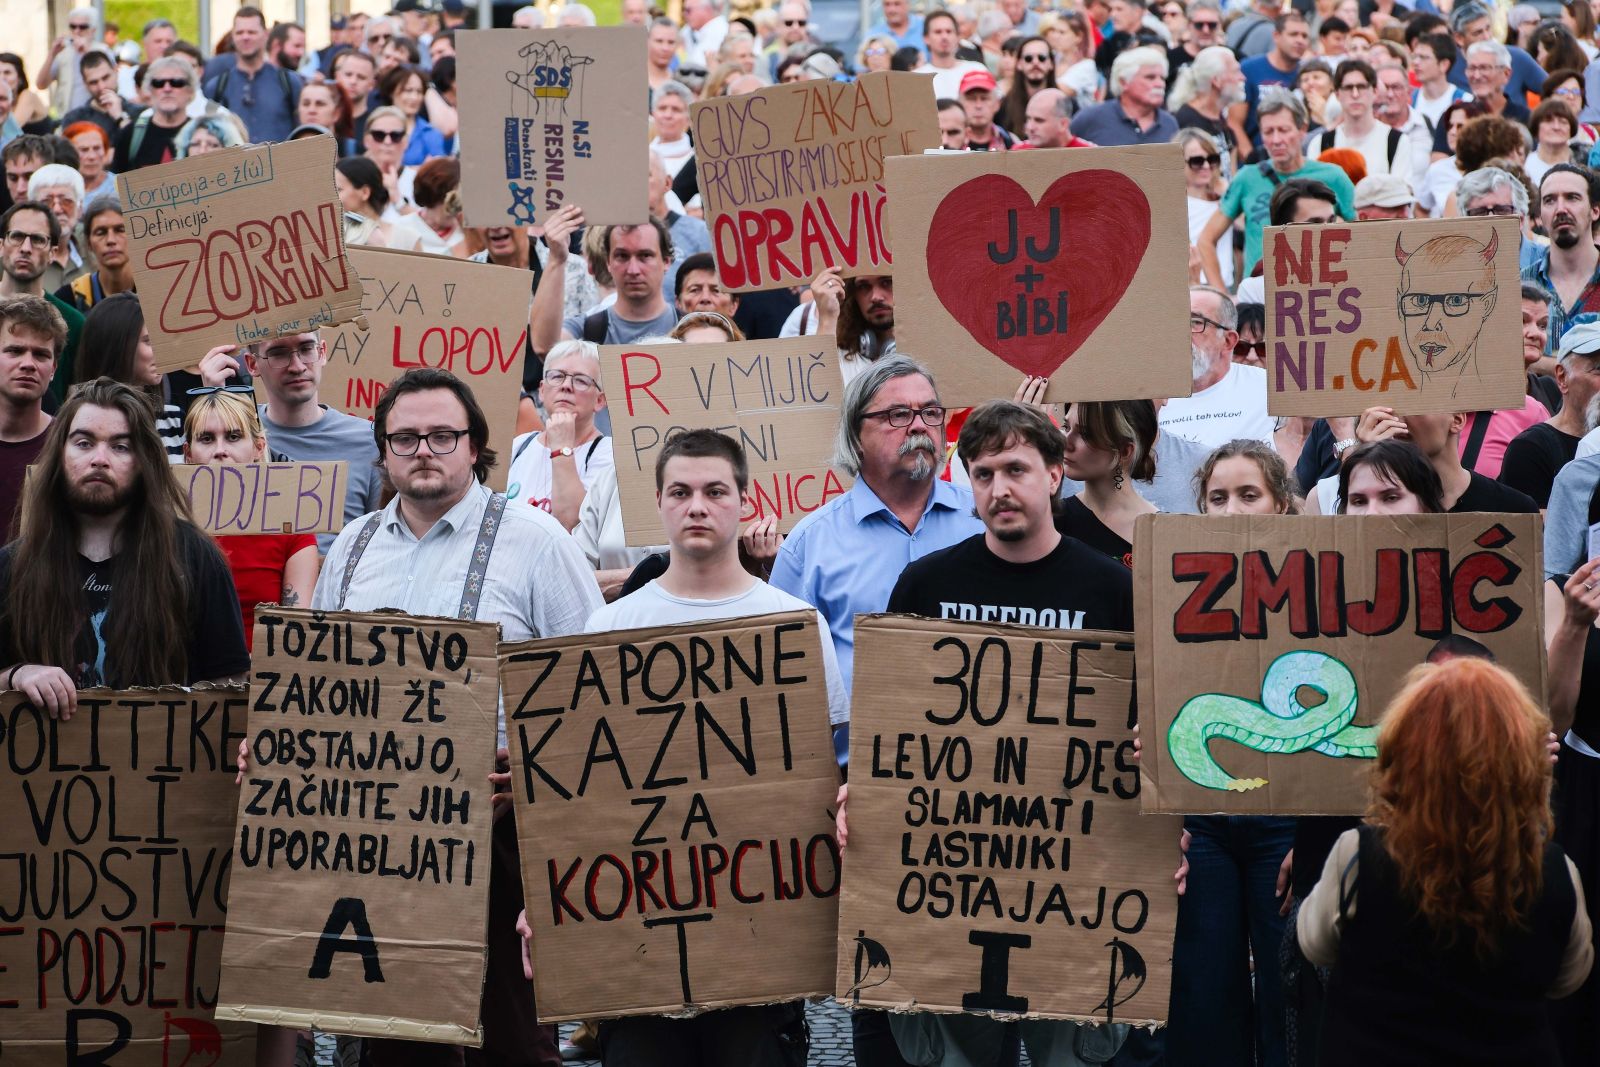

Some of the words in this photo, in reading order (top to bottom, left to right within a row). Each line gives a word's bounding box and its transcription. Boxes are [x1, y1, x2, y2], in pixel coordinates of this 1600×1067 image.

[534, 65, 571, 87] SDS
[697, 96, 770, 158] GUYS
[792, 75, 893, 143] ZAKAJ
[521, 118, 538, 181] Demokrati
[544, 124, 565, 211] RESNI.CA
[988, 207, 1060, 264] JJ
[1273, 228, 1352, 287] NE
[145, 203, 348, 333] ZORAN
[236, 320, 269, 343] (take
[276, 319, 301, 338] your
[309, 302, 333, 326] pick)
[1274, 287, 1362, 337] RES
[392, 325, 527, 376] LOPOV
[1274, 336, 1417, 392] NI.CA
[621, 352, 670, 416] R
[258, 611, 473, 686] TOŽILSTVO,
[509, 622, 807, 720] ZAPORNE
[254, 671, 380, 719] ZAKONI
[402, 680, 446, 723] ŽE
[925, 636, 1011, 727] 30
[0, 699, 249, 775] OLITIKE
[253, 728, 461, 782] OBSTAJAJO,
[519, 693, 792, 804] KAZNI
[871, 733, 972, 783] LEVO
[995, 737, 1028, 785] IN
[22, 774, 180, 846] VOLI
[245, 773, 399, 821] ZAČNITE
[408, 785, 471, 825] JIH
[631, 793, 718, 846] ZA
[905, 786, 1094, 835] SLAMNATI
[239, 825, 475, 886] UPORABLJATI
[547, 834, 841, 926] KORUPCIJO
[901, 830, 1071, 872] LASTNIKI
[896, 870, 1149, 934] OSTAJAJO
[307, 897, 386, 983] A
[643, 912, 713, 1003] T
[961, 929, 1032, 1013] I
